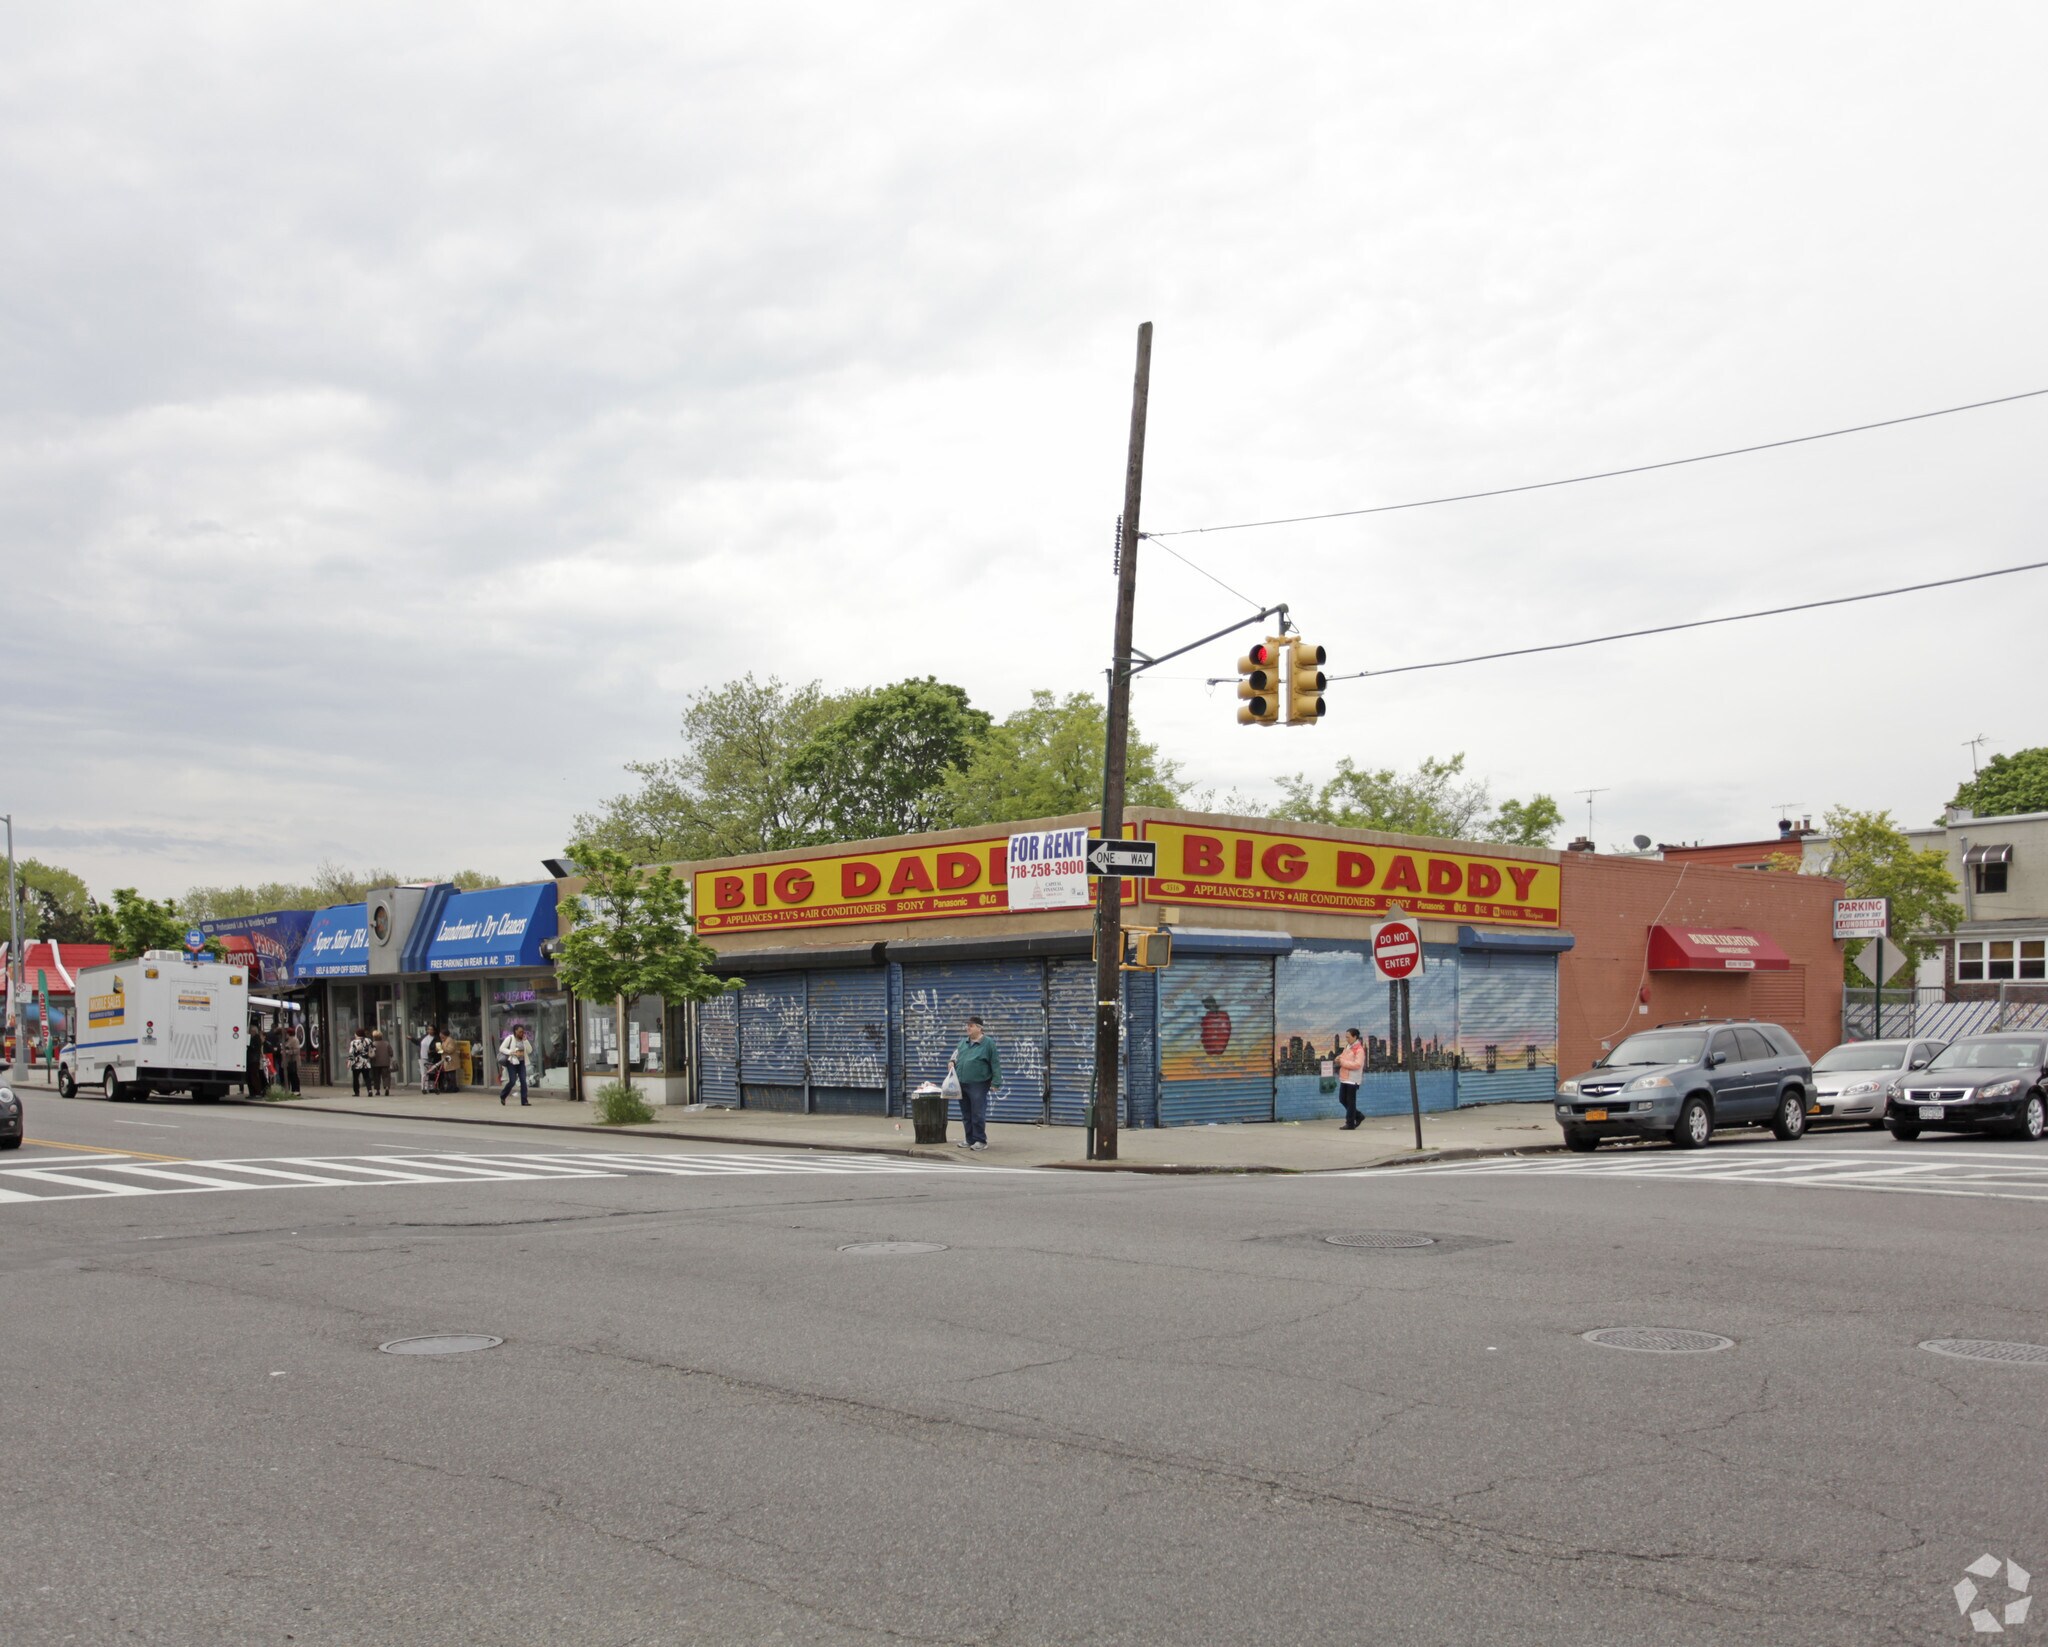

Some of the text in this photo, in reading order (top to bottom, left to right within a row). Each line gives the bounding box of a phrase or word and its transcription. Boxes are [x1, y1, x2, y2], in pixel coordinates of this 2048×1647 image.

[1010, 831, 1085, 863] FOR RENT
[1096, 852, 1149, 865] ONE WAY
[1010, 860, 1085, 879] 718-258-3900
[1182, 834, 1541, 901] BIG DADDY
[714, 846, 1009, 910] BIG DAD
[1193, 884, 1255, 899] APPLIANCES
[1262, 890, 1285, 900] T.V'S
[1293, 893, 1309, 902] AIR
[1310, 893, 1376, 907] CONDITIONERS
[1417, 900, 1446, 911] Panasonic
[726, 912, 772, 924] APPLIANCES
[779, 910, 798, 920] T.V'S
[804, 909, 820, 919] AIR
[821, 903, 887, 917] CONDITIONERS
[896, 900, 925, 911] SONY
[933, 897, 967, 909] Panasonic
[986, 894, 997, 905] LG
[1837, 901, 1882, 912] PARKING
[437, 918, 477, 942] Laundromat
[481, 915, 499, 944] Dry
[497, 912, 528, 936] Cleaners
[1837, 920, 1882, 929] LAUNDROMAT
[312, 931, 333, 957] Super
[1380, 931, 1409, 945] DO NOT
[227, 952, 255, 965] PHOTO
[431, 959, 443, 968] FREE
[443, 958, 463, 968] PARKING
[463, 958, 470, 967] IN
[469, 957, 482, 966] REAR
[483, 956, 489, 965] &
[489, 955, 499, 965] A/C
[1384, 957, 1411, 969] ENTER
[329, 966, 341, 975] DROP
[341, 965, 349, 974] OFF
[349, 964, 367, 973] SERVICE
[90, 995, 121, 1010] MOBILE SALES
